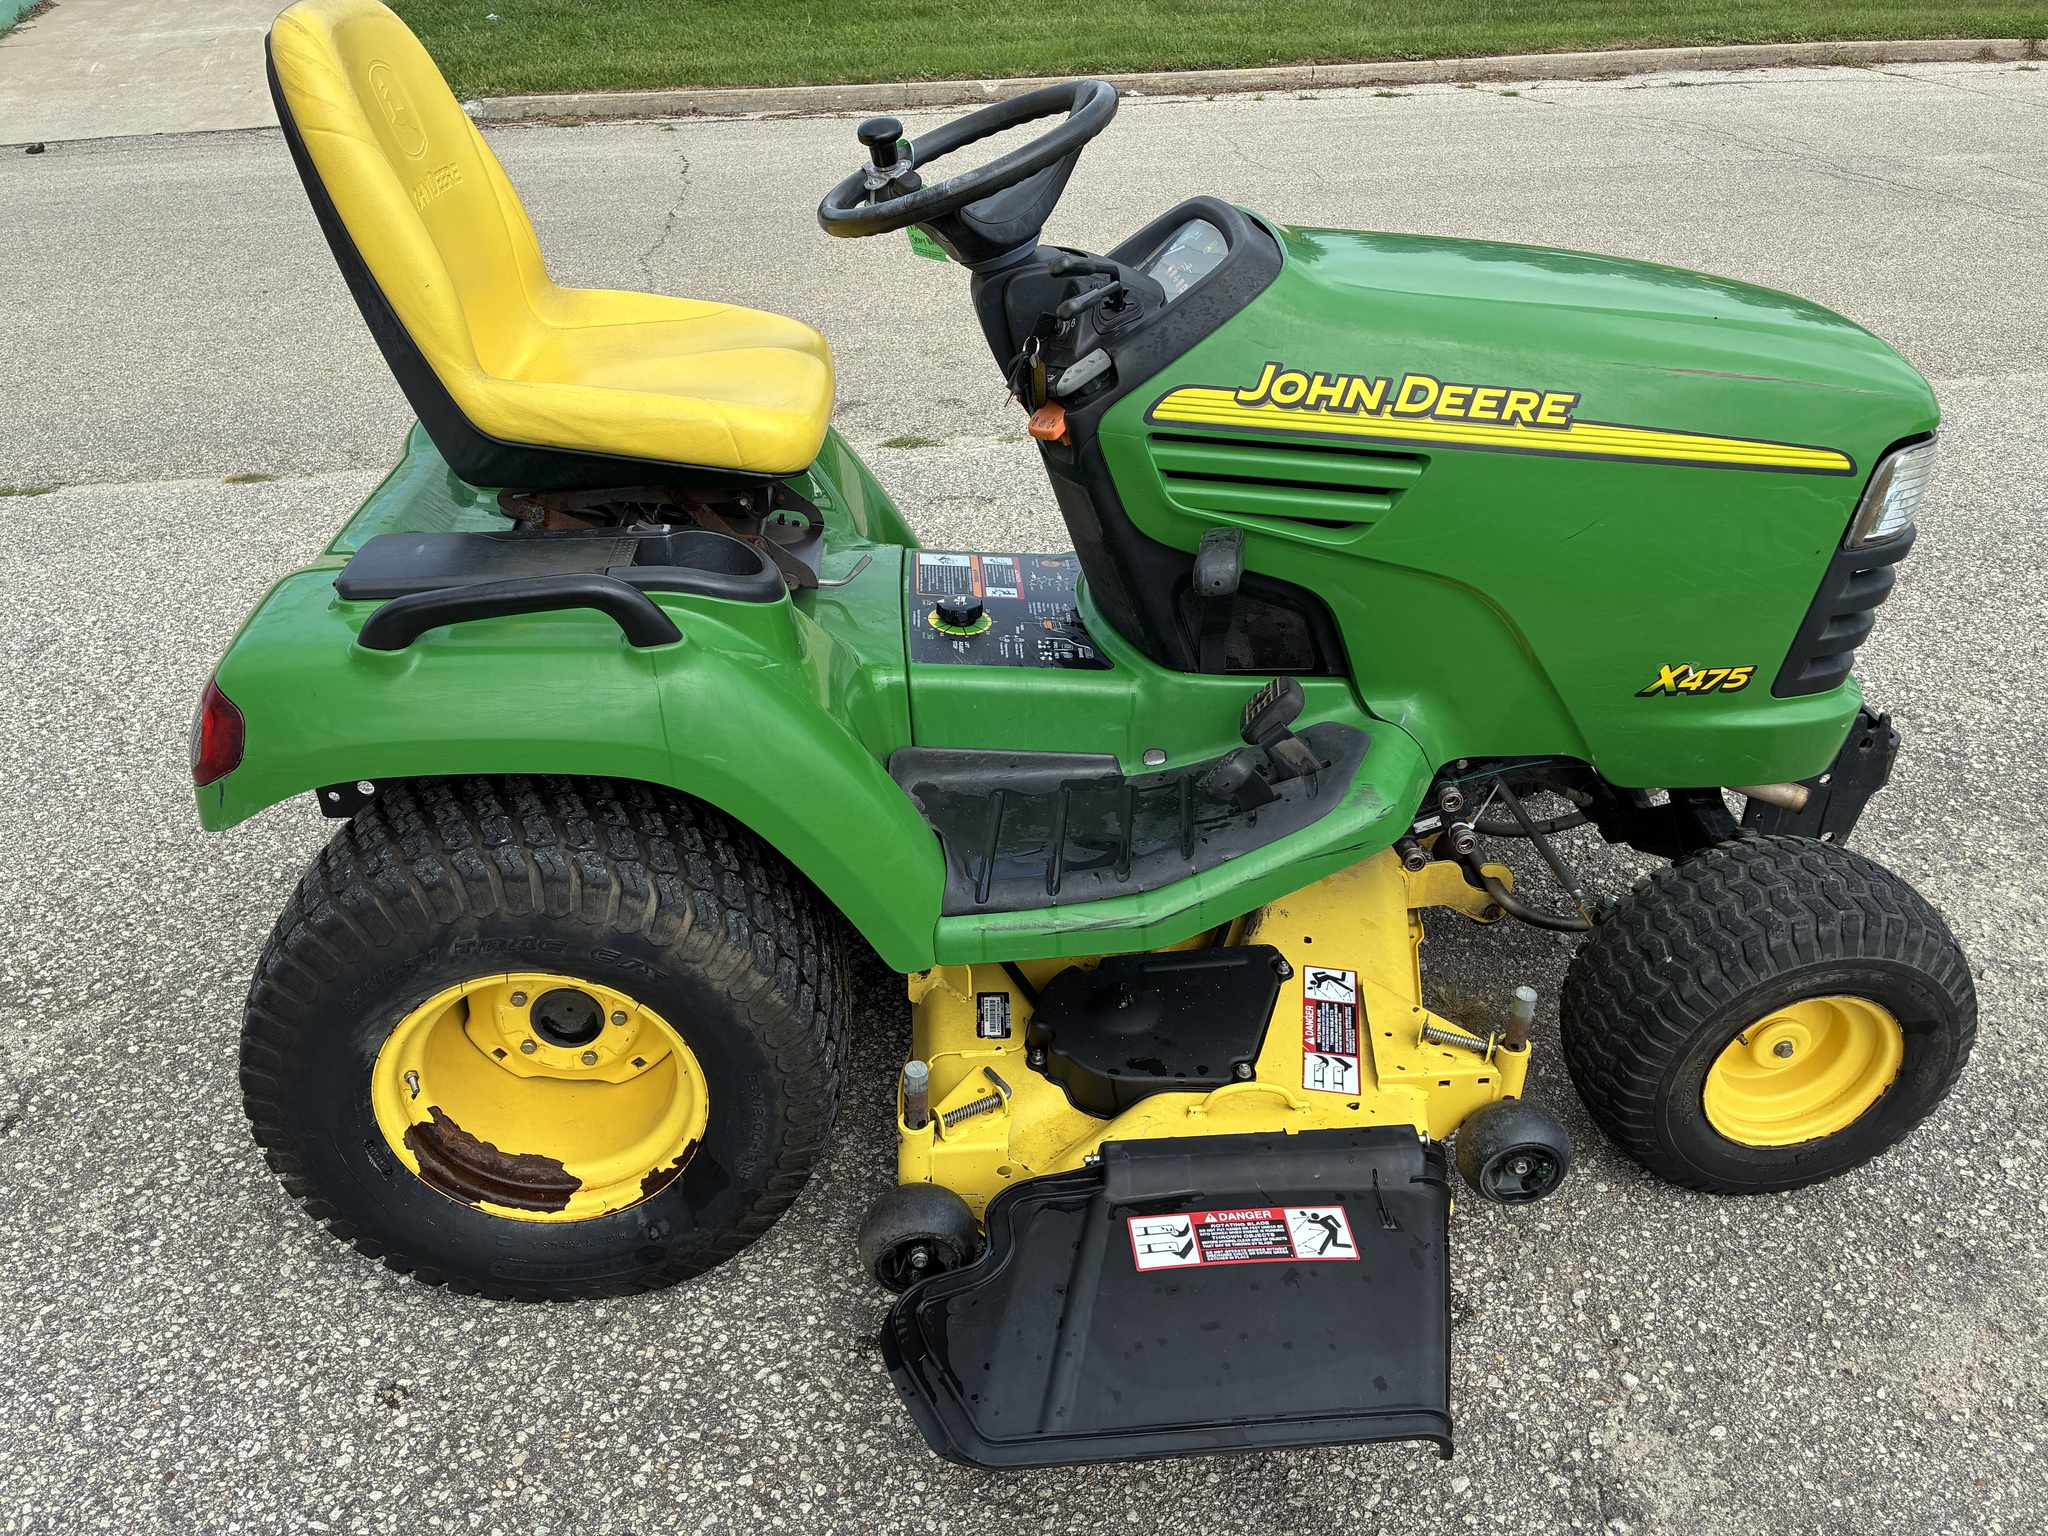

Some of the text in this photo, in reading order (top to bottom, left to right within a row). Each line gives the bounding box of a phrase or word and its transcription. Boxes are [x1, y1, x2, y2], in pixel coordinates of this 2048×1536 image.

[426, 162, 464, 197] DEERE
[1235, 362, 1579, 429] JOHN DEERE
[1635, 663, 1758, 697] X475
[341, 947, 439, 1016] MULTI
[455, 936, 568, 957] TRAC
[1305, 1005, 1313, 1036] DANGER
[1218, 1211, 1272, 1221] DANGER
[585, 1238, 595, 1247] IN
[600, 1231, 627, 1245] MADE
